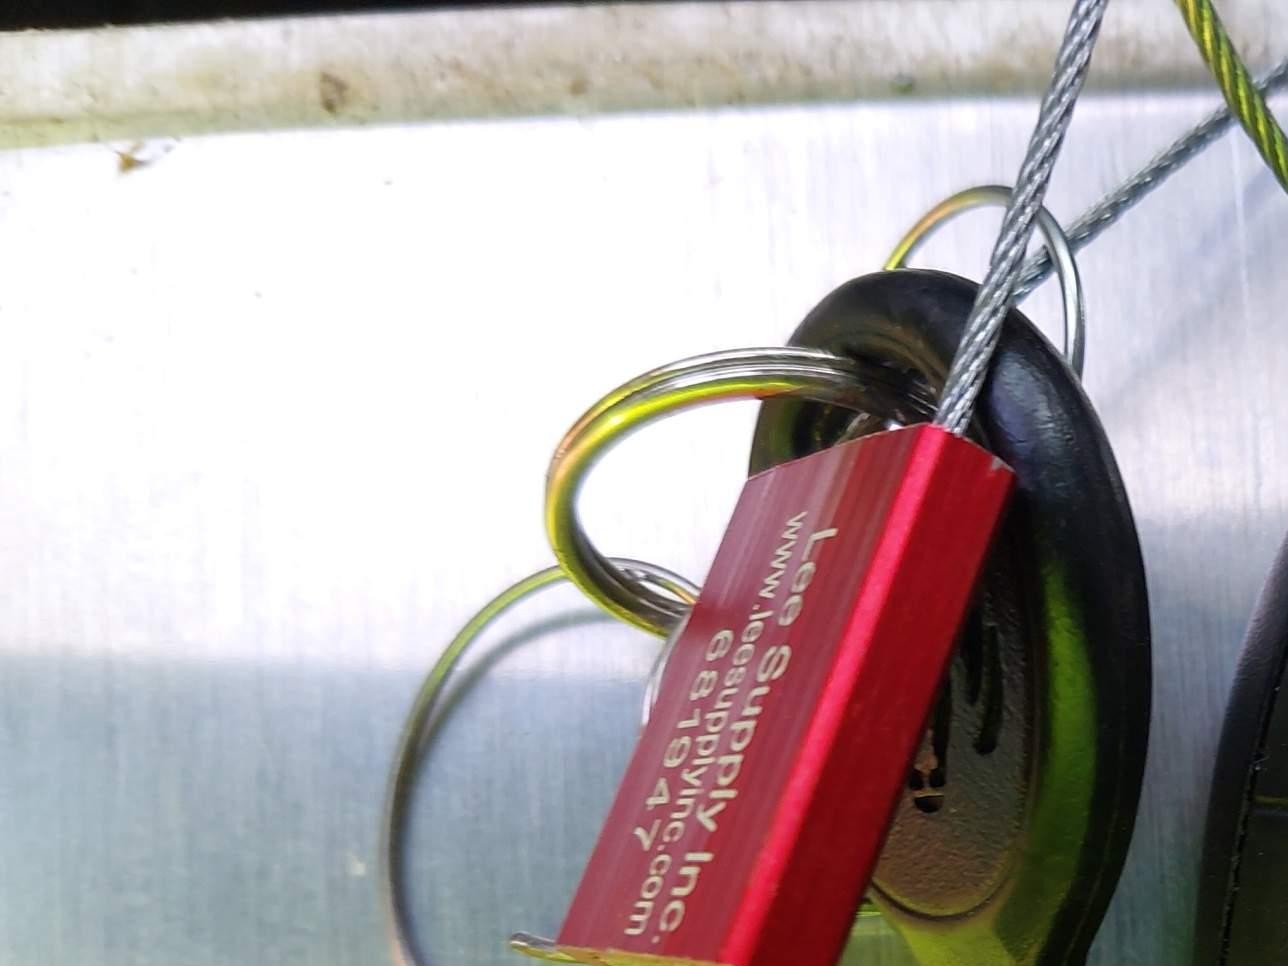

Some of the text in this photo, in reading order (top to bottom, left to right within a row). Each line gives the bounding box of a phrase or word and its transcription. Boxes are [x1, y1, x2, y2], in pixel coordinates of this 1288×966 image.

[624, 511, 808, 936] www.leesupplyinc.com
[634, 629, 732, 852] 681947
[652, 527, 838, 944] Lee Supply Inc.
